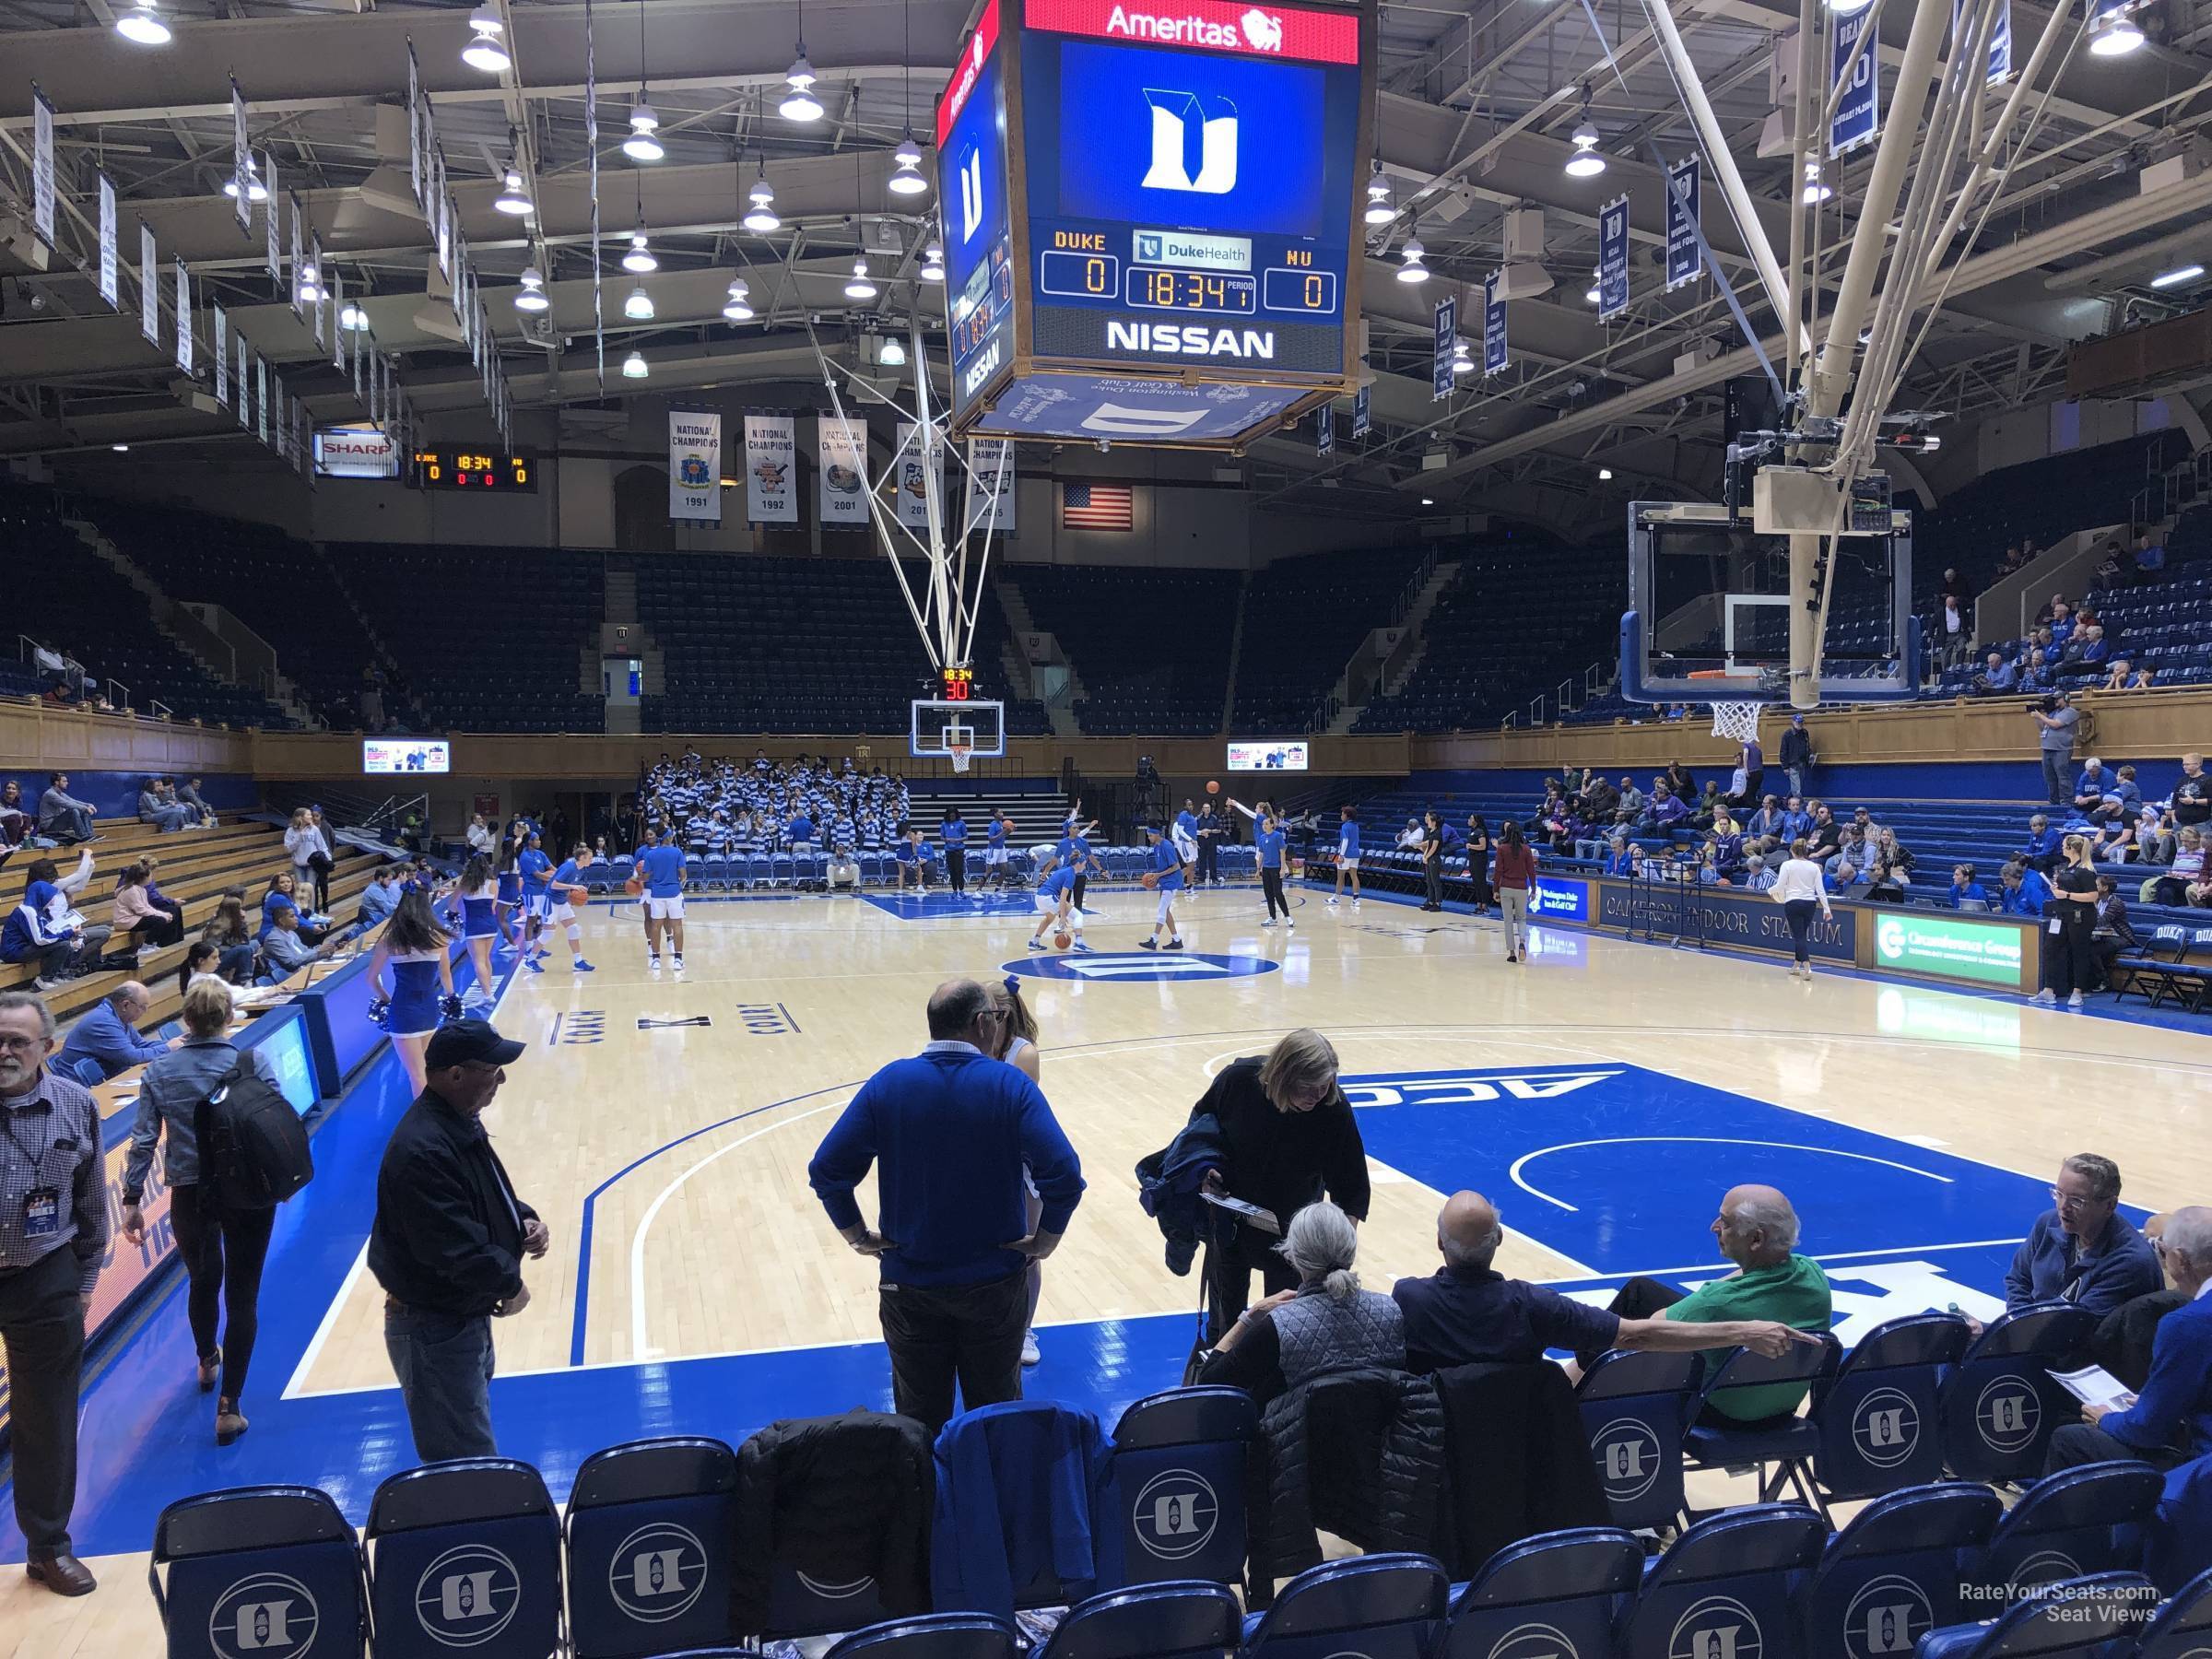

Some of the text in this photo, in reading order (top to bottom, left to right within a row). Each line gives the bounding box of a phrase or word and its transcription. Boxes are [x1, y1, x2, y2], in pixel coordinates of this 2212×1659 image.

[1054, 230, 1106, 251] DUKE
[1168, 243, 1245, 261] DukeHealth
[1087, 258, 1105, 292] 0
[1147, 272, 1224, 308] 18:34
[1227, 280, 1253, 291] PERIOD
[1304, 276, 1322, 308] 0
[1107, 322, 1274, 359] NISSAN
[966, 338, 999, 397] NISSAN
[1091, 384, 1199, 397] Washington Duke
[677, 425, 713, 436] NATIONAL
[752, 429, 788, 440] NATIONAL
[324, 442, 392, 455] SHARP
[672, 436, 718, 448] CHAMPIONS
[748, 441, 793, 451] CHAMPIONS
[457, 455, 491, 469] 18:34
[429, 466, 440, 479] 0
[516, 469, 525, 483] 0
[685, 497, 708, 507] 1991
[761, 500, 784, 510] 1992
[834, 501, 856, 510] 2001
[944, 669, 972, 680] 18:34
[947, 680, 968, 700] 30
[1542, 889, 1578, 901] Washington Duke
[1606, 896, 1680, 923] CAMERON
[1685, 906, 1748, 934] INDOOR
[2157, 926, 2183, 940] DUKE
